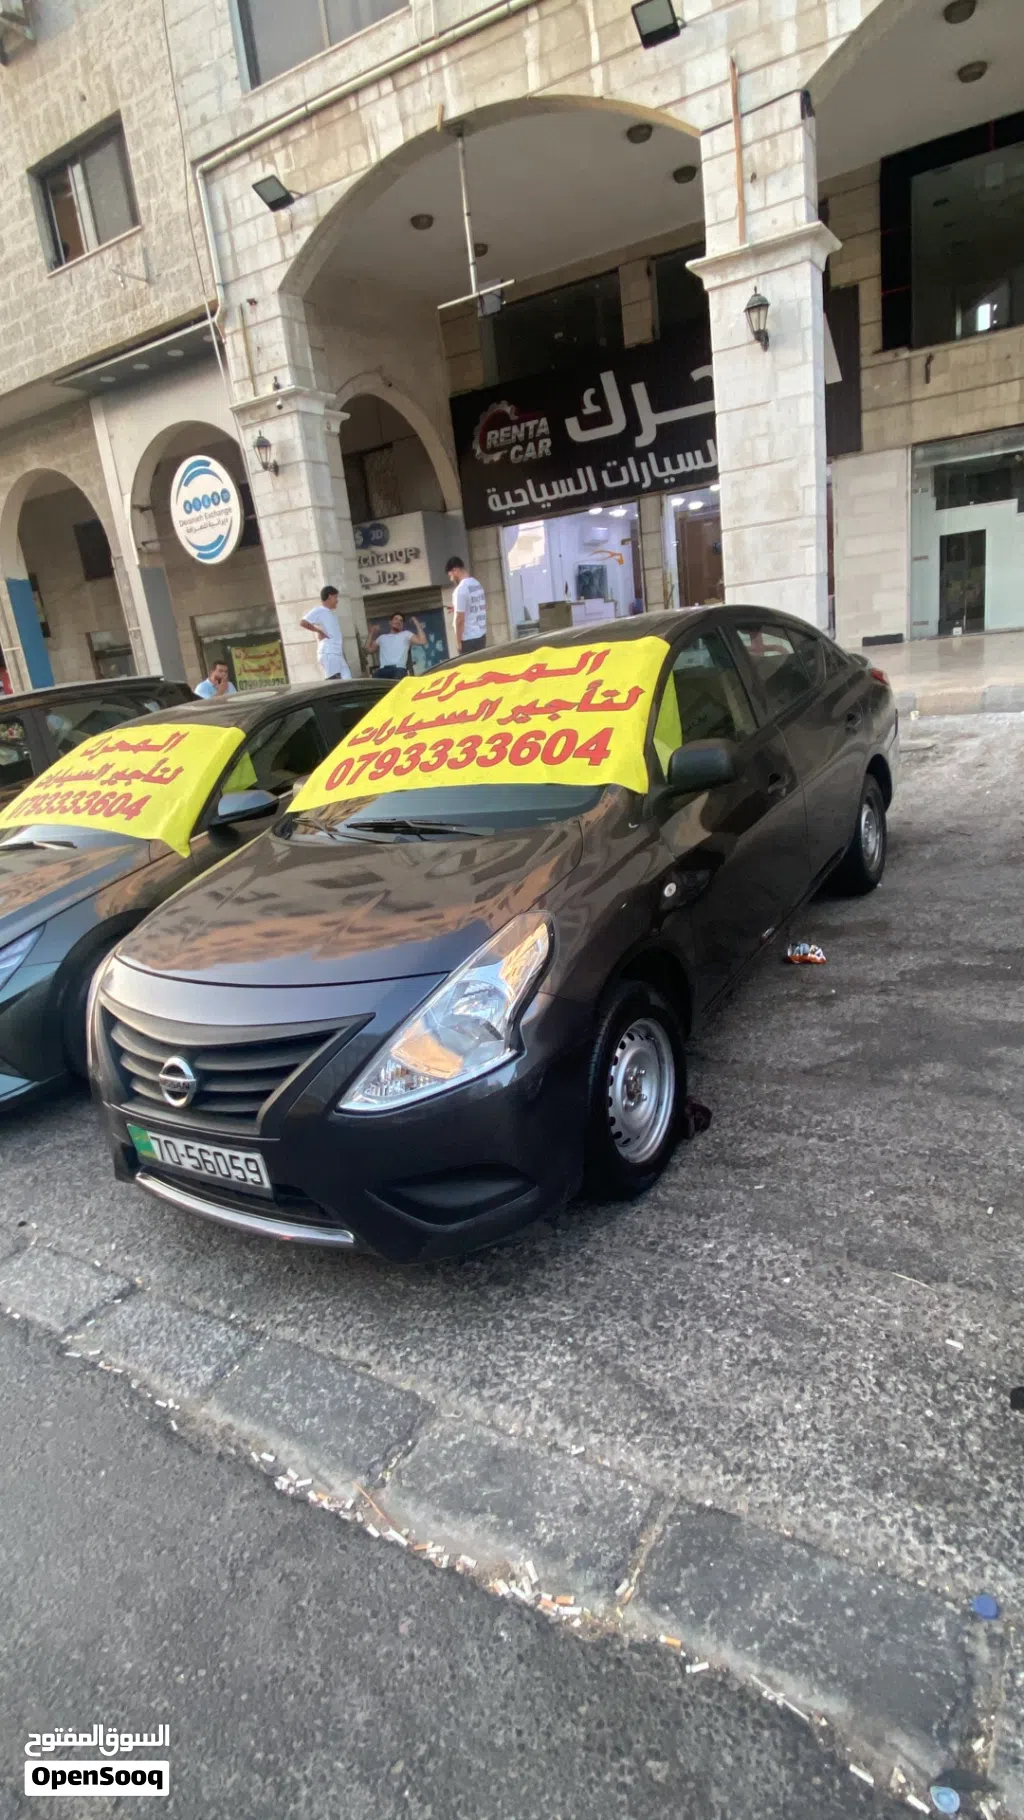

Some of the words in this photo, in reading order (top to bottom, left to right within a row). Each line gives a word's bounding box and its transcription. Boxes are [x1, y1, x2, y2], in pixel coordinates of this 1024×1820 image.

[486, 416, 550, 449] RENTA
[509, 438, 552, 464] CAR
[601, 438, 719, 489] لسيارات
[204, 506, 232, 519] Exchange
[486, 464, 598, 516] السياحية
[411, 649, 611, 702] المحرك
[80, 730, 190, 761] المحرك
[347, 697, 503, 747] السيارات
[325, 727, 614, 791] 0793333604
[150, 1136, 264, 1186] 70-56059
